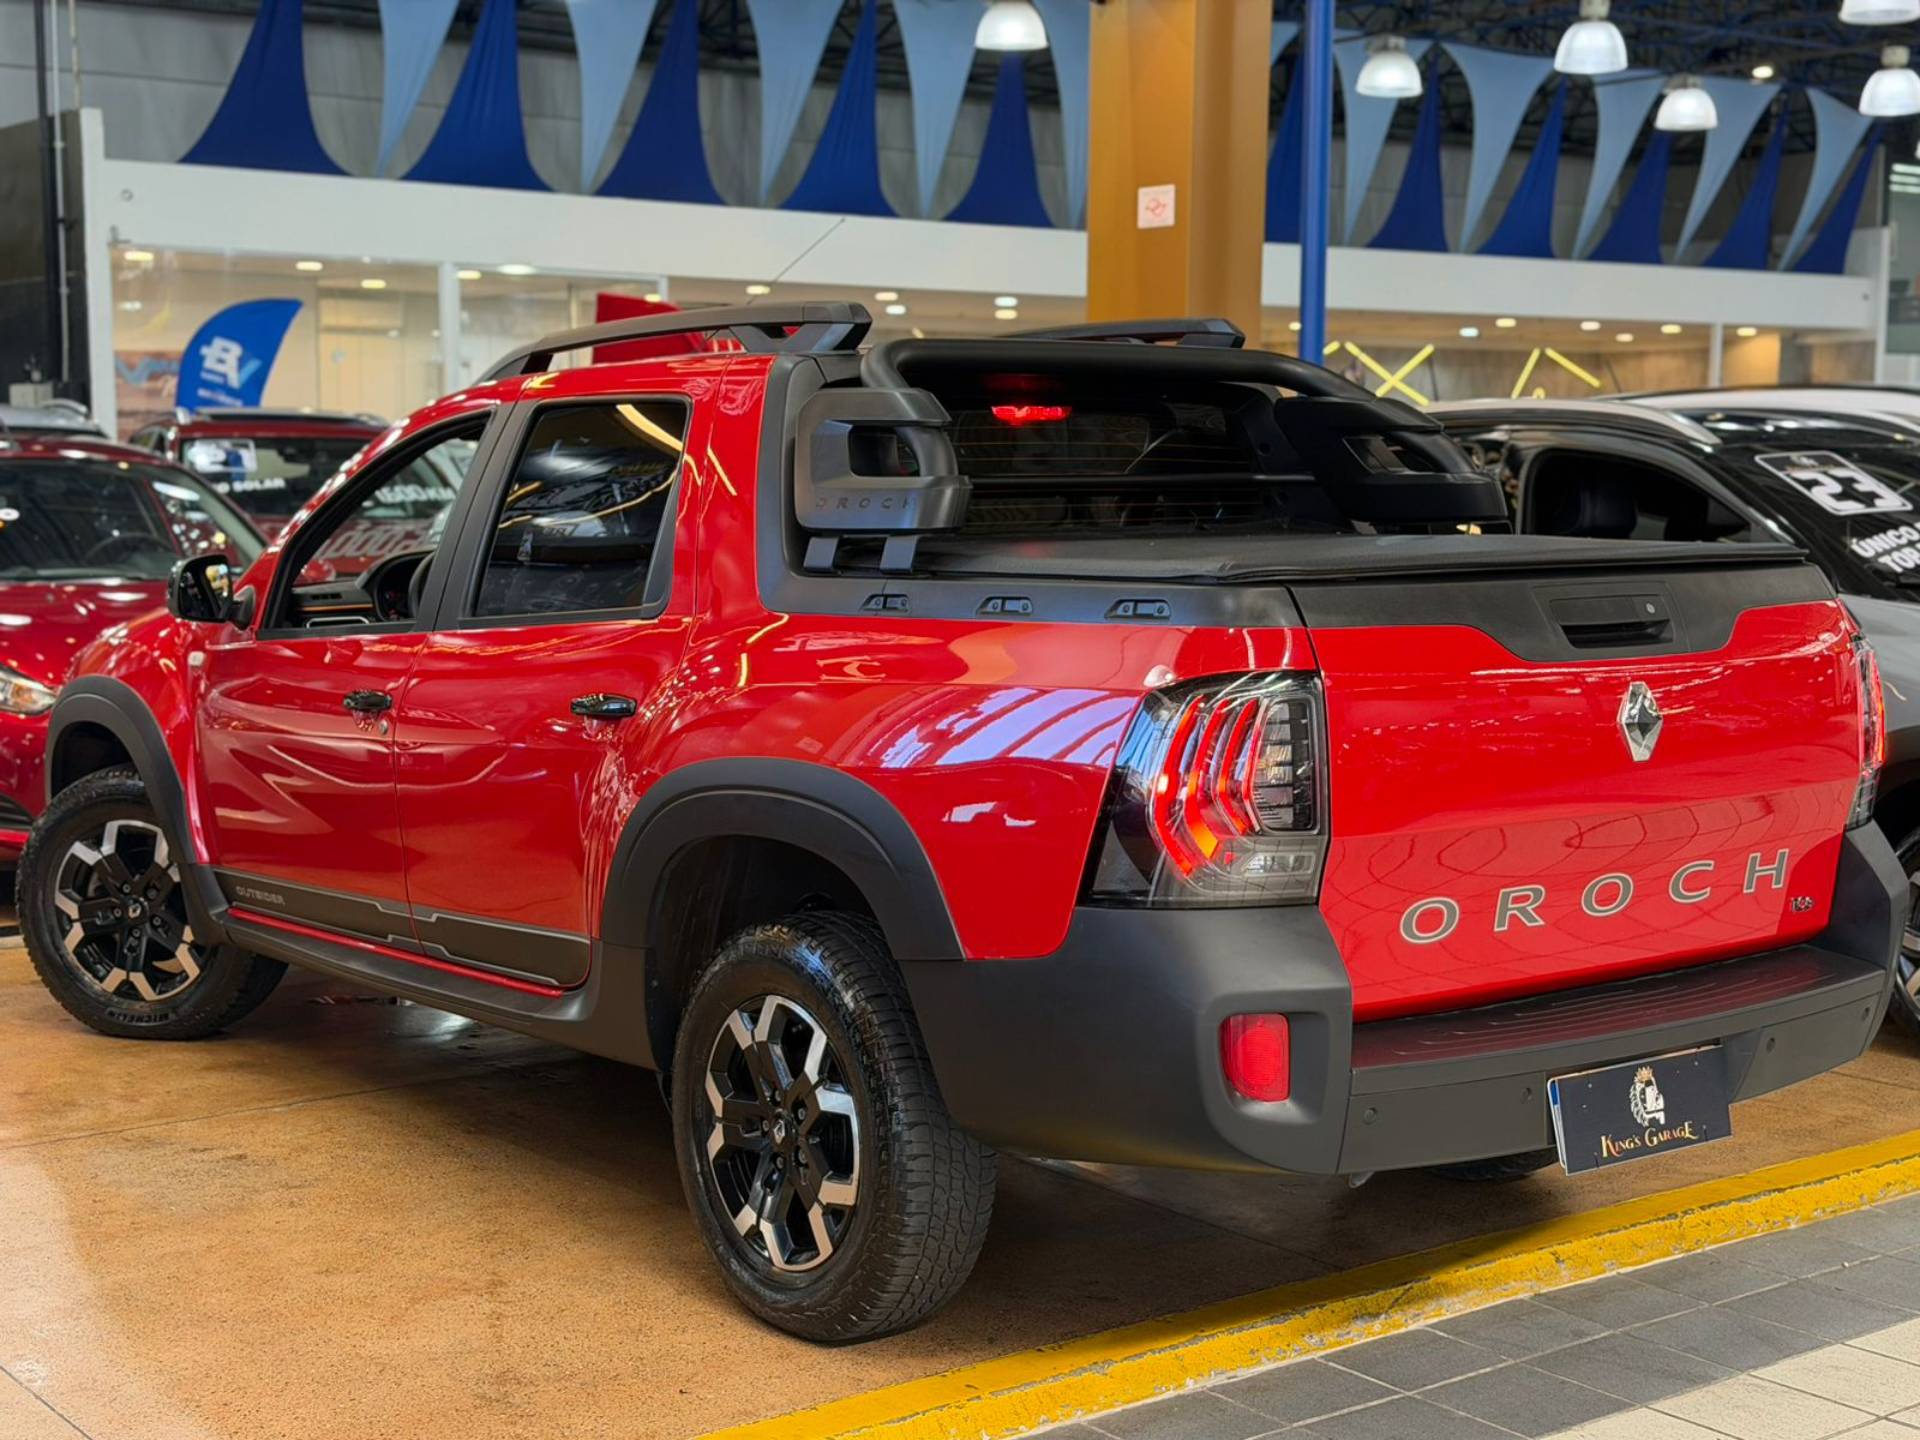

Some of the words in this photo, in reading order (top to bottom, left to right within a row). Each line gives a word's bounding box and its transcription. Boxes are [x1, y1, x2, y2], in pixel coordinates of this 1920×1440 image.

[1790, 468, 1905, 511] 23
[1850, 525, 1920, 558] ÚNICO
[1399, 848, 1790, 945] OROCH
[1644, 1120, 1699, 1147] GARAGE
